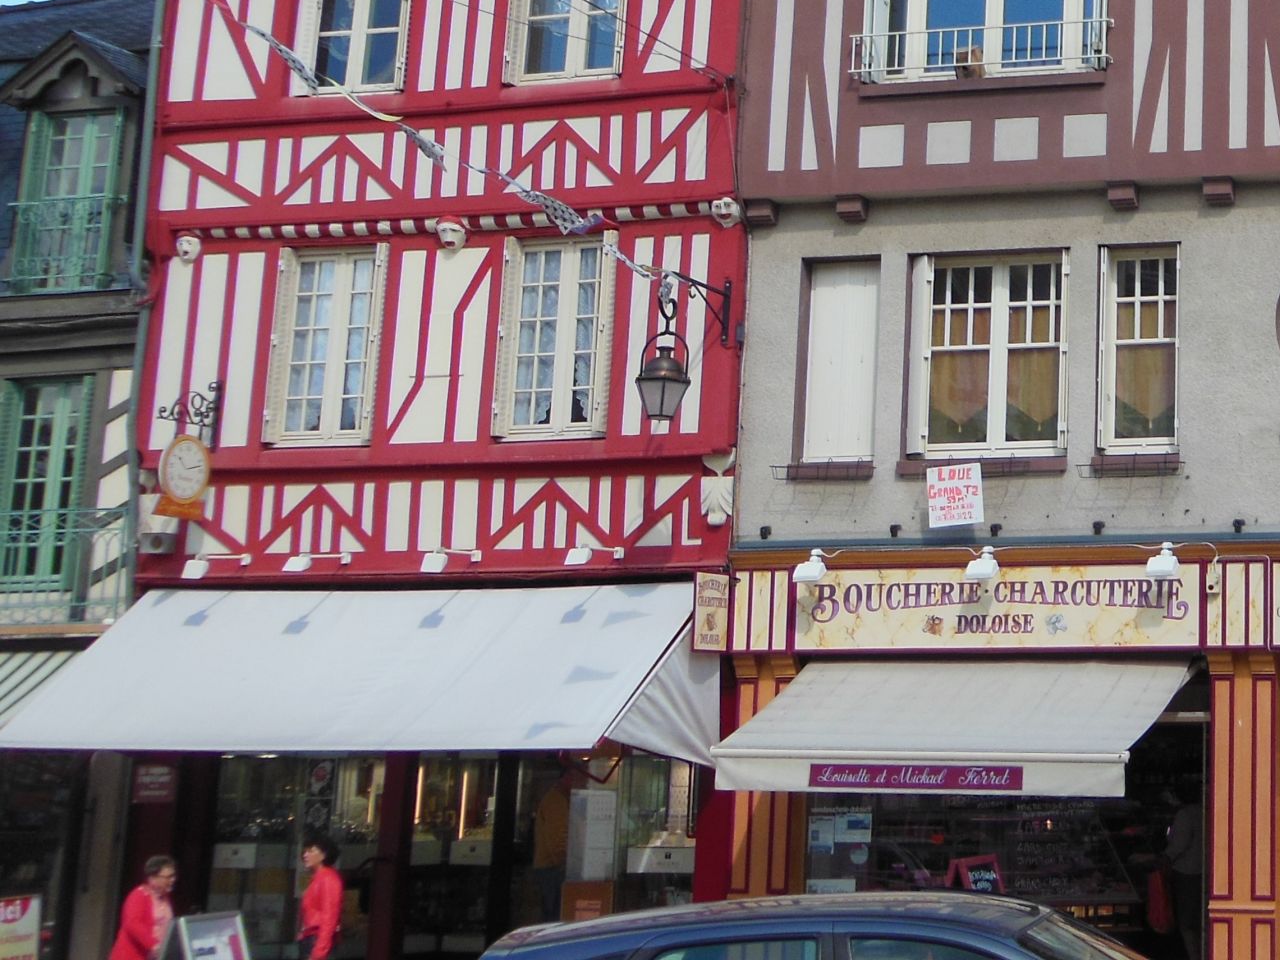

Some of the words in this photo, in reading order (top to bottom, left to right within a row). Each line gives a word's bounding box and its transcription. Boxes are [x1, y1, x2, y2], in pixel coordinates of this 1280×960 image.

[937, 466, 972, 481] LOUE
[928, 485, 962, 499] GRAND
[811, 583, 981, 623] BOUCHERIE
[994, 578, 1189, 620] CHARCUTERIE
[955, 614, 1034, 634] DOLOISE
[817, 766, 871, 783] Louisette
[873, 769, 887, 783] et
[891, 766, 947, 784] Mickael
[958, 767, 1010, 785] Ferret
